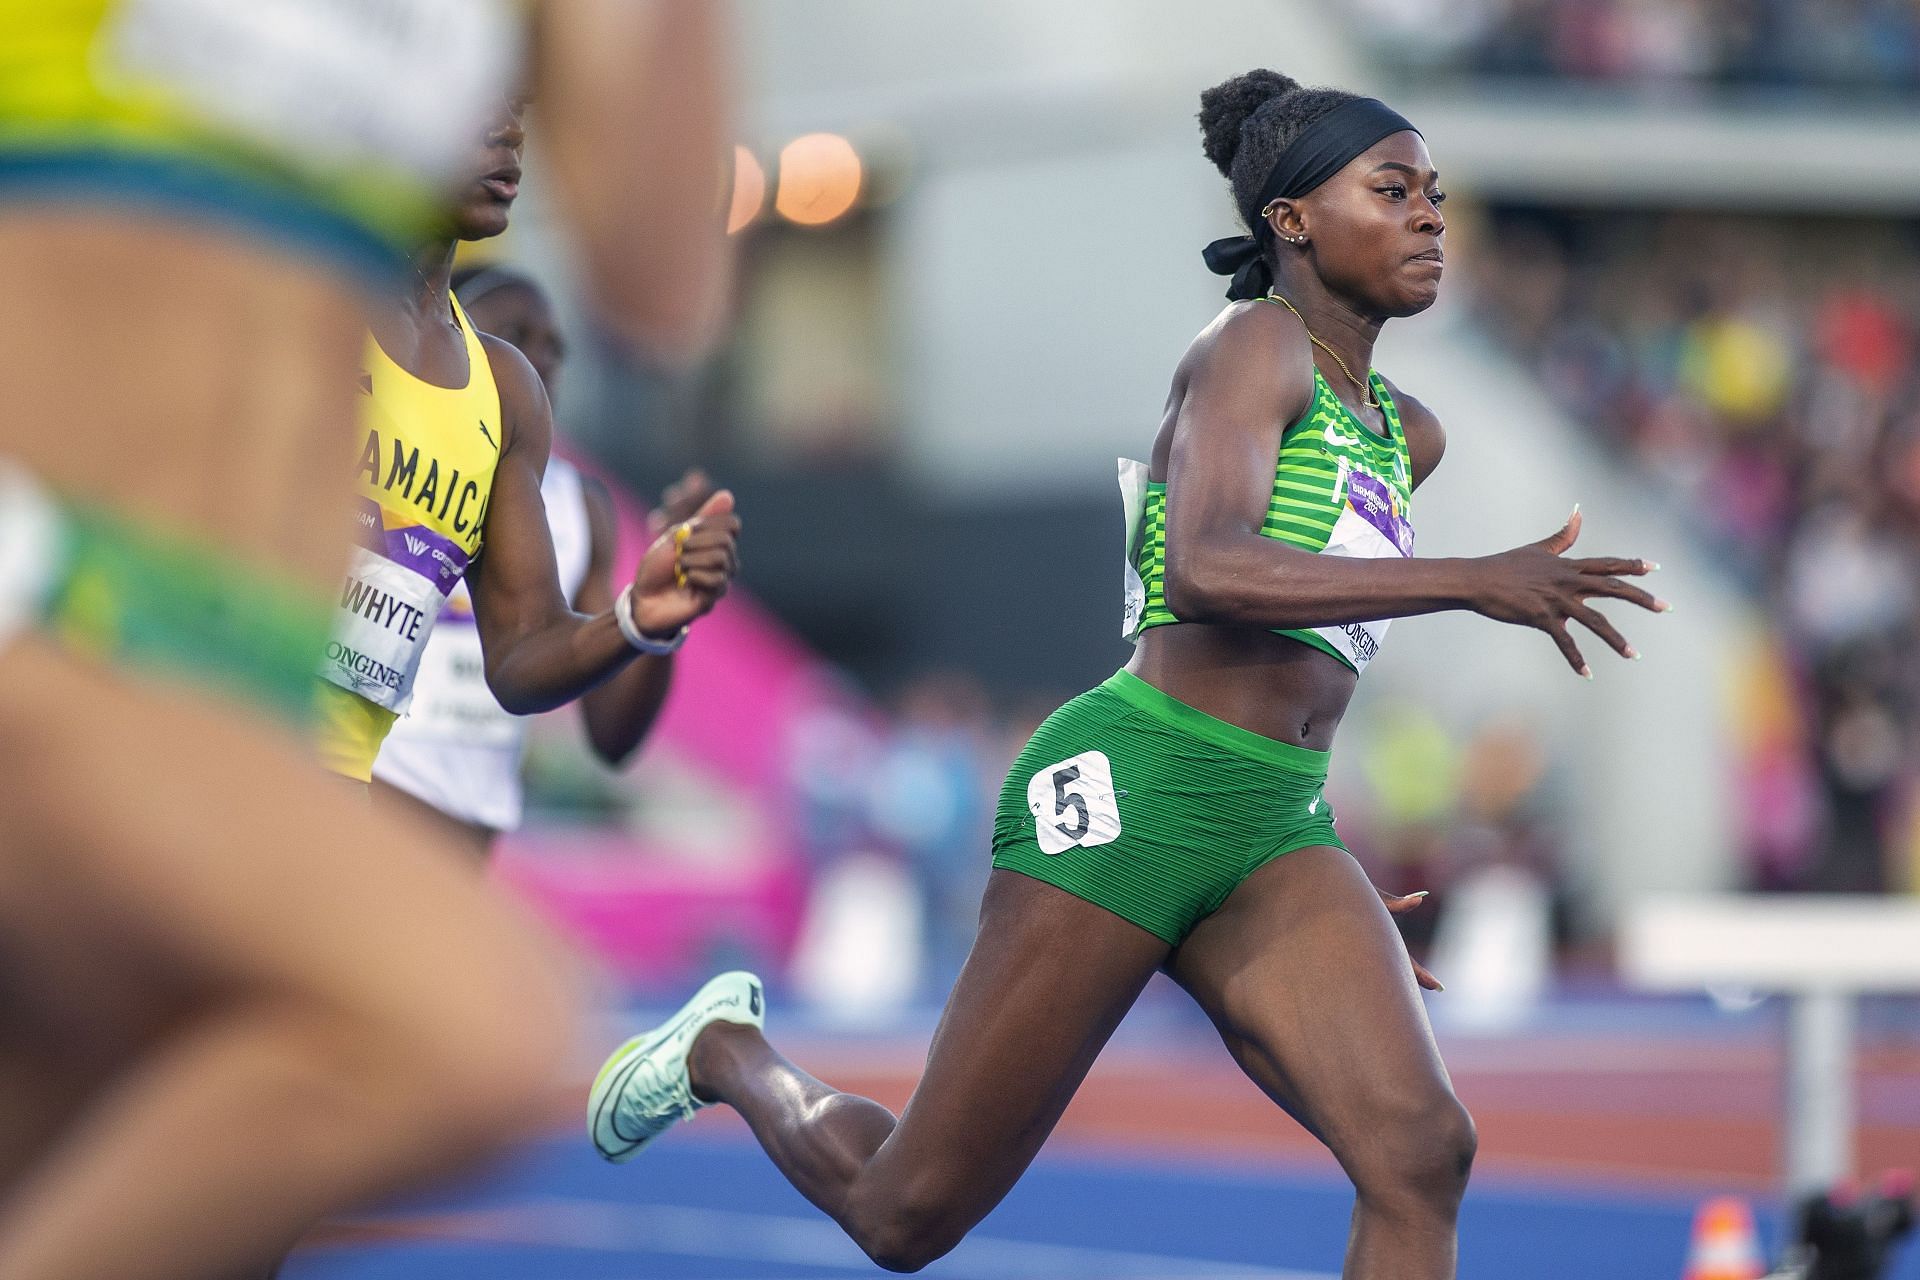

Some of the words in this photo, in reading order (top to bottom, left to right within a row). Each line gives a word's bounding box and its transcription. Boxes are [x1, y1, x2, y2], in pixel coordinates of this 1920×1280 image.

[356, 429, 487, 546] AMAICA
[1352, 483, 1389, 515] BIRMINGHAM
[340, 576, 424, 643] WHYTE
[326, 641, 405, 692] ONGINES
[1340, 623, 1379, 661] ONGIN
[1052, 764, 1090, 841] 5
